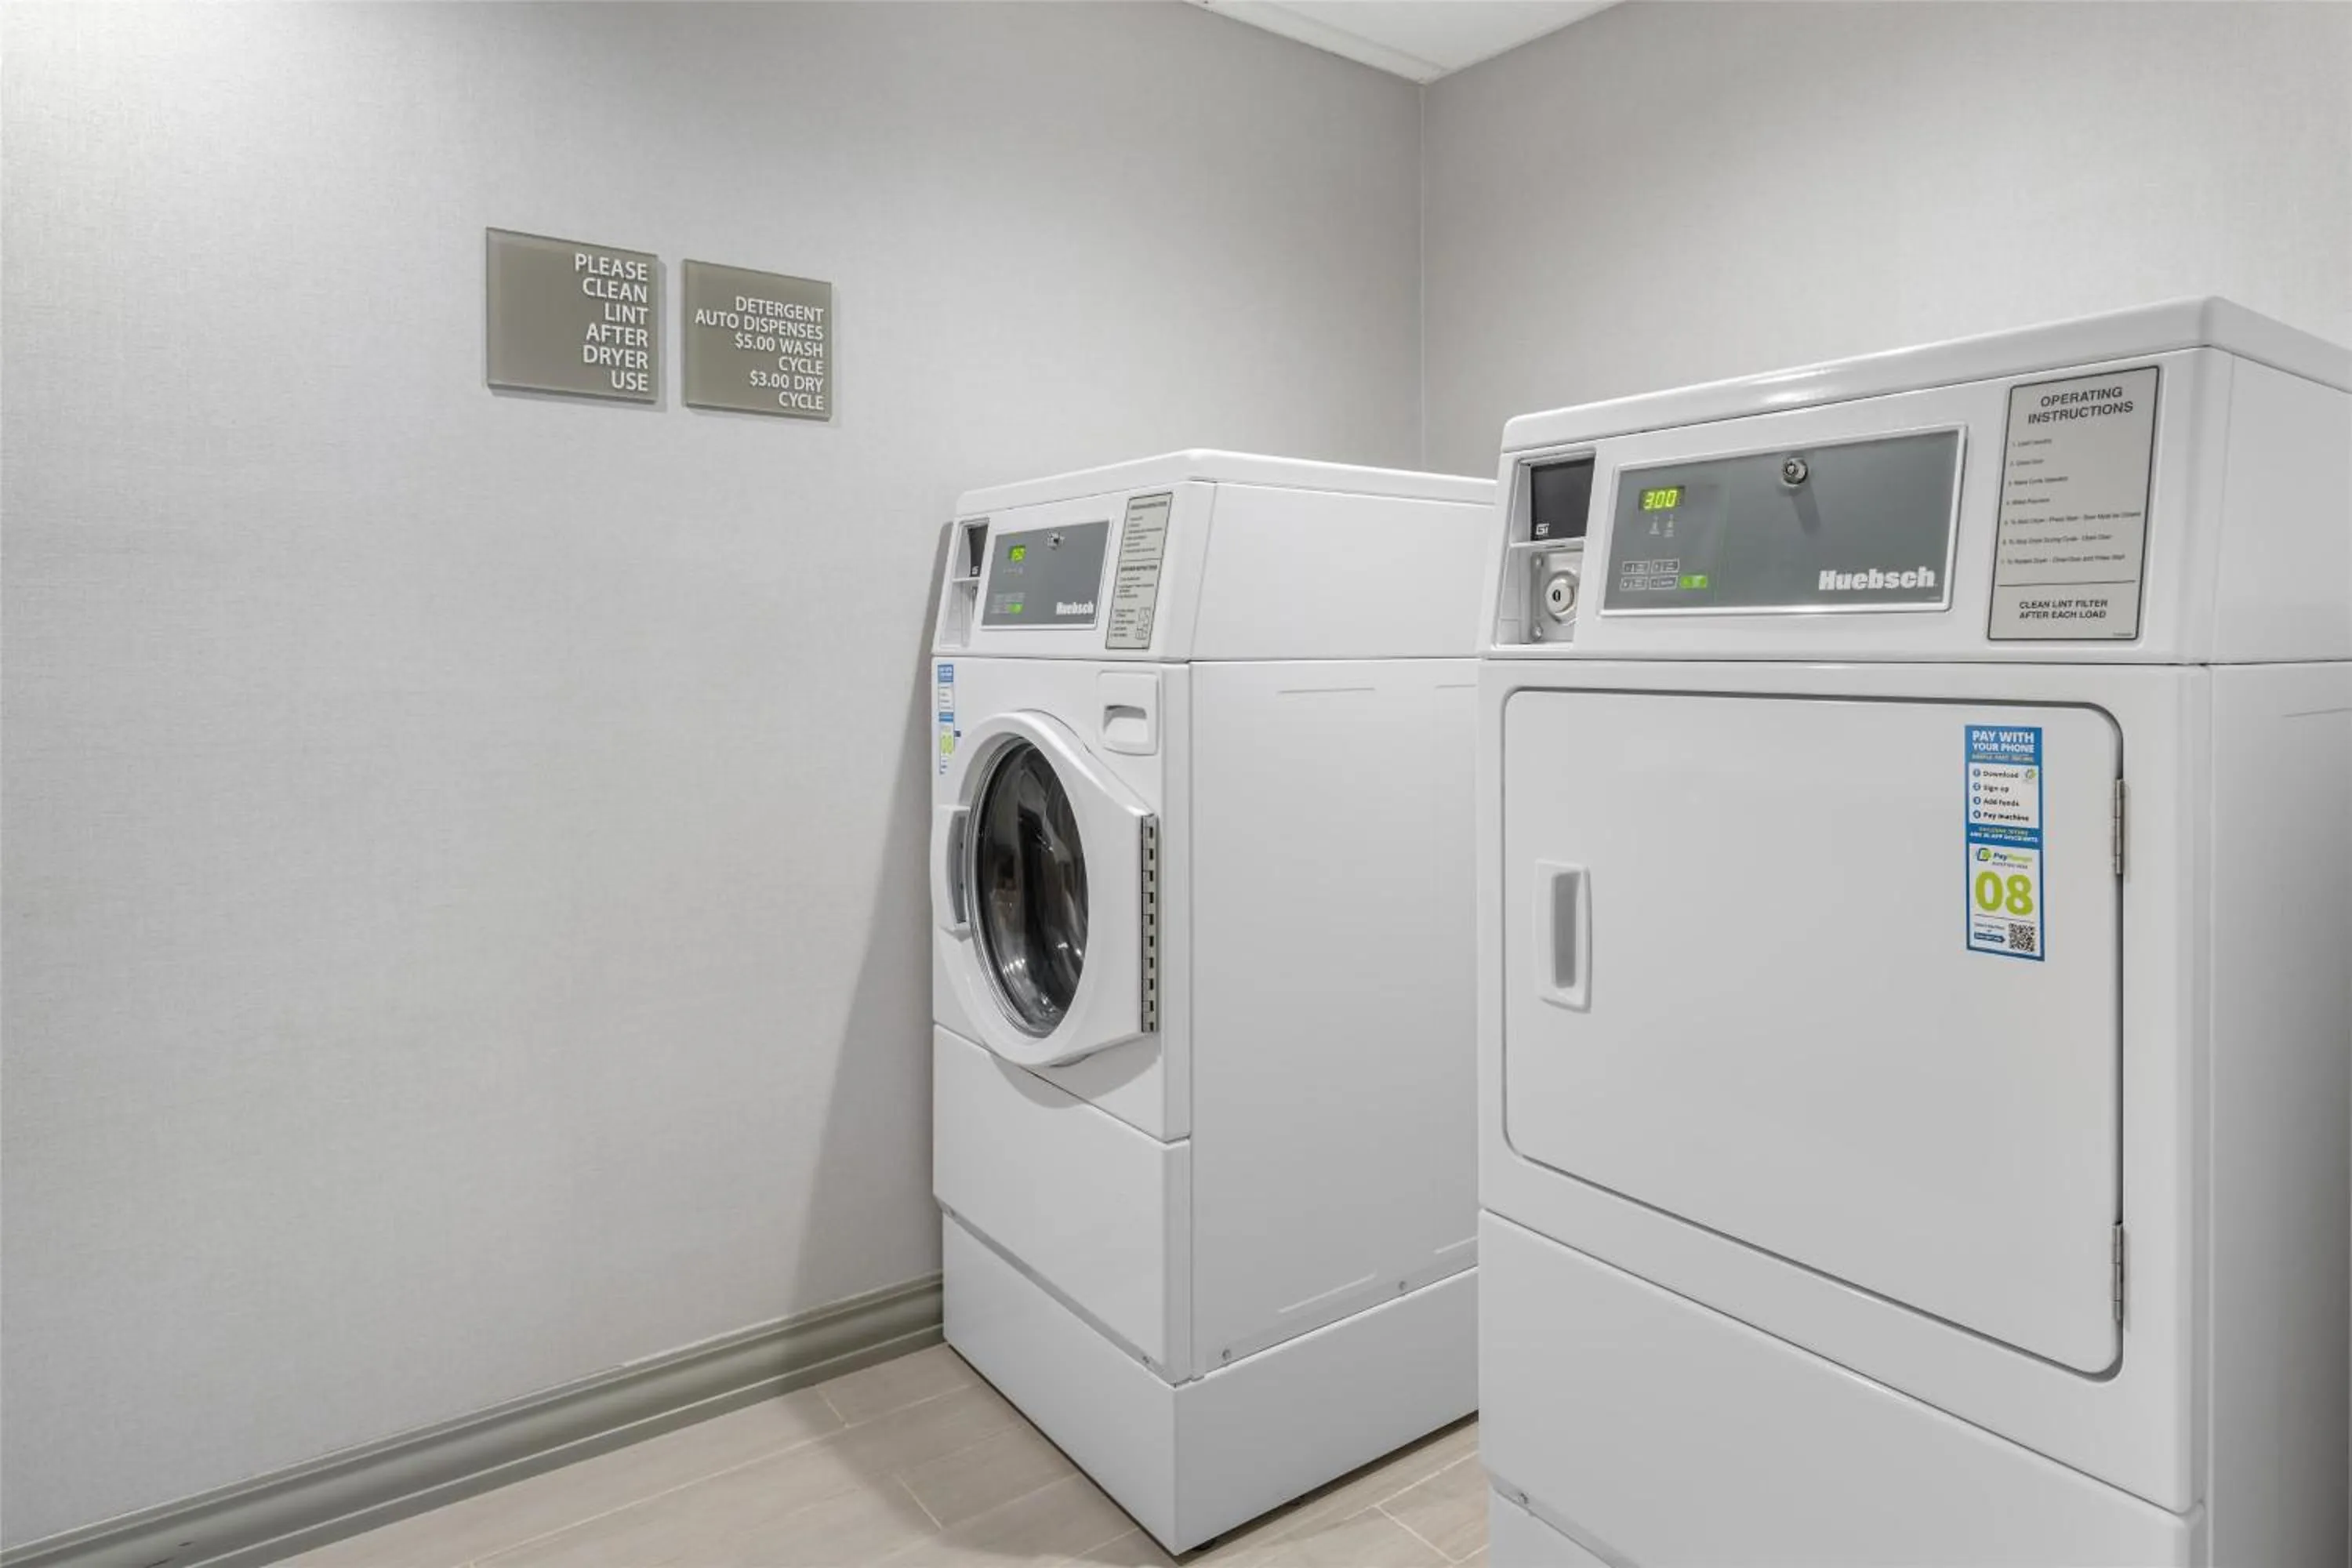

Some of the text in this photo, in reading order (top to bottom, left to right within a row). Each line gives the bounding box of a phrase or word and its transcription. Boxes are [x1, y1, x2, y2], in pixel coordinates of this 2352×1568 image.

[575, 252, 648, 281] PLEASE
[583, 277, 647, 303] CLEAN
[604, 302, 648, 325] LINT
[735, 295, 824, 322] DETERGENT
[586, 322, 648, 348] AFTER
[695, 308, 823, 340] AUTO DISPENSES
[583, 344, 648, 369] DRYER
[735, 332, 823, 358] $5.00 WASH
[779, 356, 823, 376] CYCLE
[611, 369, 648, 391] USE
[750, 369, 823, 393] $3.00 DRY
[779, 391, 824, 410] CYCLE
[2041, 387, 2123, 407] OPERATING
[2027, 401, 2133, 424] INSTRUCTIONS
[1818, 565, 1936, 591] Huebsch
[2019, 599, 2108, 609] CLEAN LINT FILTER
[2019, 611, 2049, 619] AFTER
[2078, 610, 2107, 619] LOAD
[1972, 730, 2034, 744] PAY WITH
[1972, 742, 2034, 753] YOUR PHONE
[1976, 870, 2034, 916] 08
